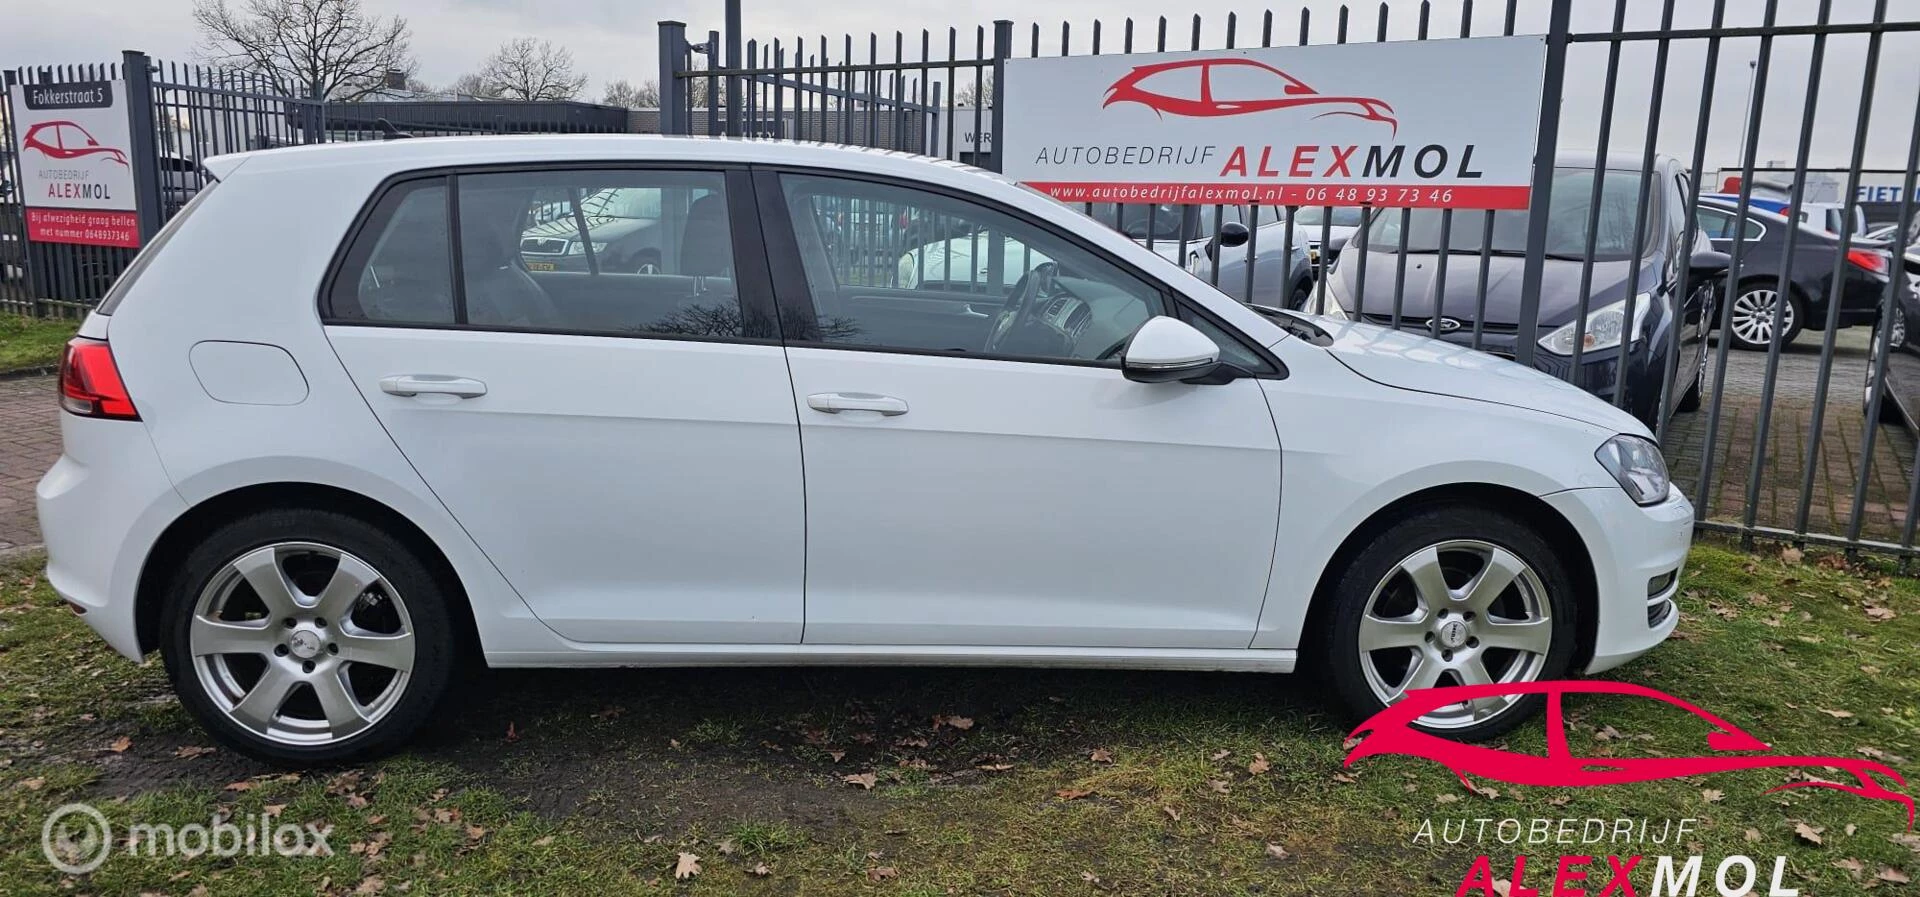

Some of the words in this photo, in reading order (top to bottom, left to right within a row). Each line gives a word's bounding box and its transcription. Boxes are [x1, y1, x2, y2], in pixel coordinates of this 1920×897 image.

[33, 88, 94, 105] Fokkerstraat
[97, 87, 103, 103] 5
[1035, 145, 1216, 165] AUTOBEDRIJF
[1219, 144, 1483, 179] ALEXMOL
[38, 169, 89, 180] AUTOBEDRIJF
[48, 183, 111, 199] ALEXMOL
[1050, 185, 1283, 202] www.autobedrijfalexmol.nl
[1306, 187, 1327, 201] 06
[1336, 187, 1357, 201] 48
[1366, 188, 1388, 202] 93
[1397, 188, 1419, 202] 73
[1429, 188, 1452, 203] 46
[31, 212, 41, 224] Bij
[43, 213, 86, 225] afwezigheid
[87, 216, 109, 227] graag
[111, 215, 135, 226] bellen
[40, 228, 53, 236] met
[55, 229, 82, 238] nummer
[84, 229, 130, 241] 0648937346
